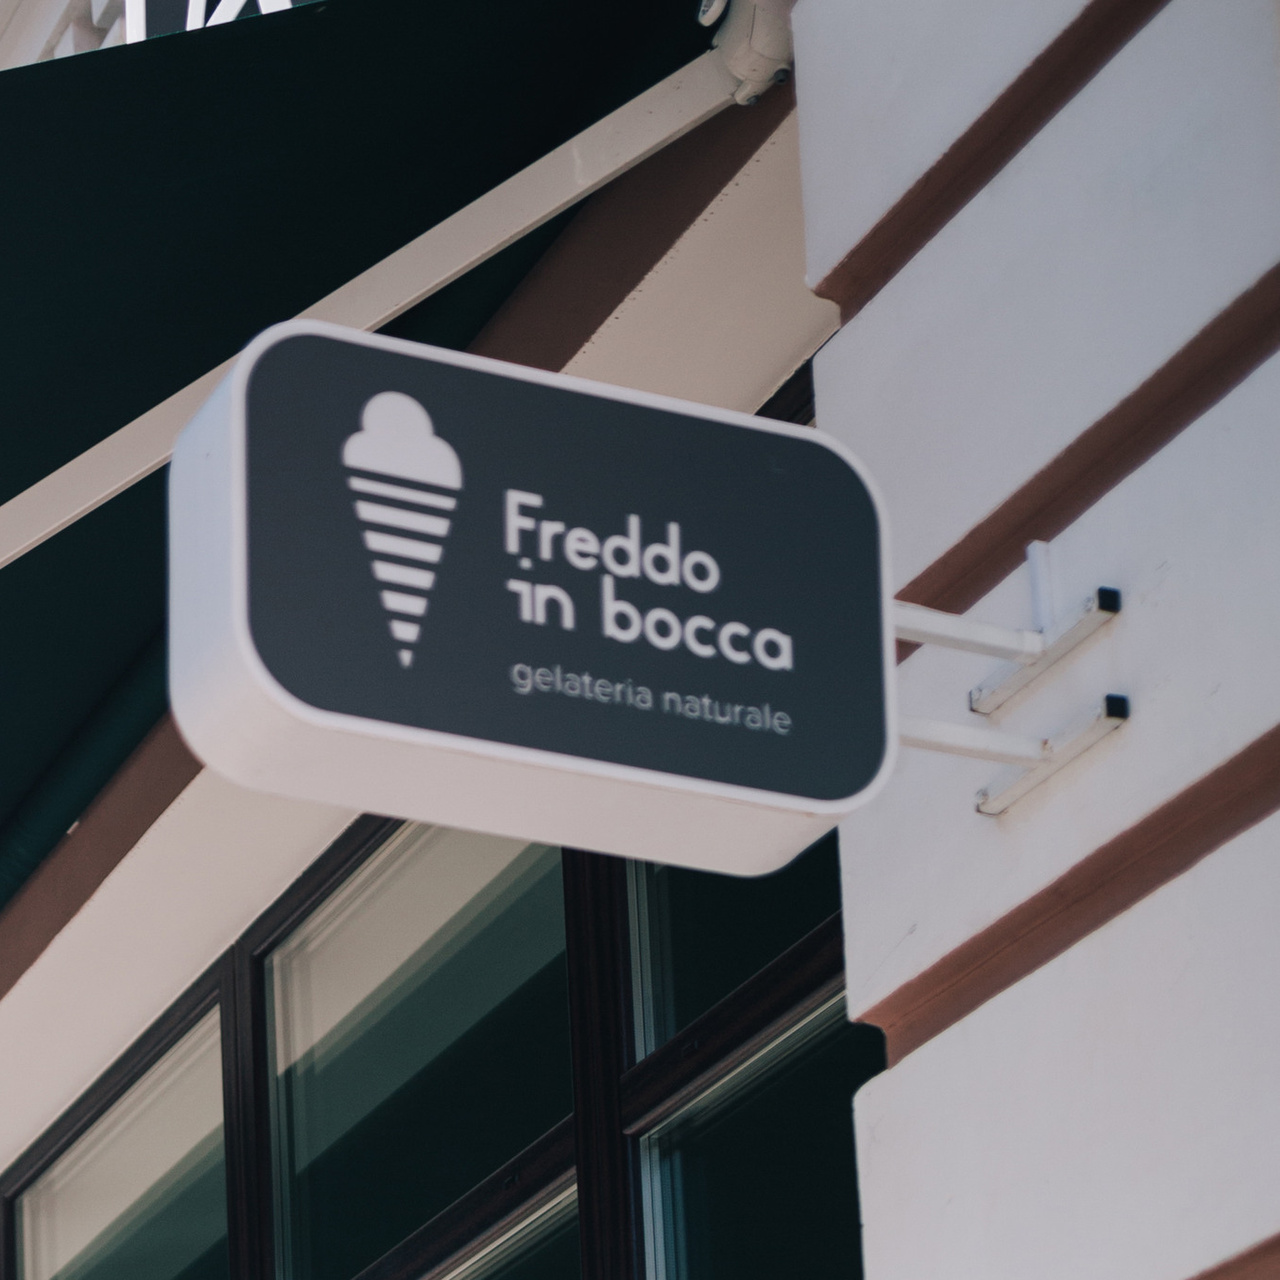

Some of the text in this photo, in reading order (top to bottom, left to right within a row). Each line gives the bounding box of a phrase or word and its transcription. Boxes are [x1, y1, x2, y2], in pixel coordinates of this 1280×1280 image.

[504, 488, 721, 593] Freddo
[505, 557, 794, 671] in bocca
[510, 662, 793, 736] gelateria naturale
